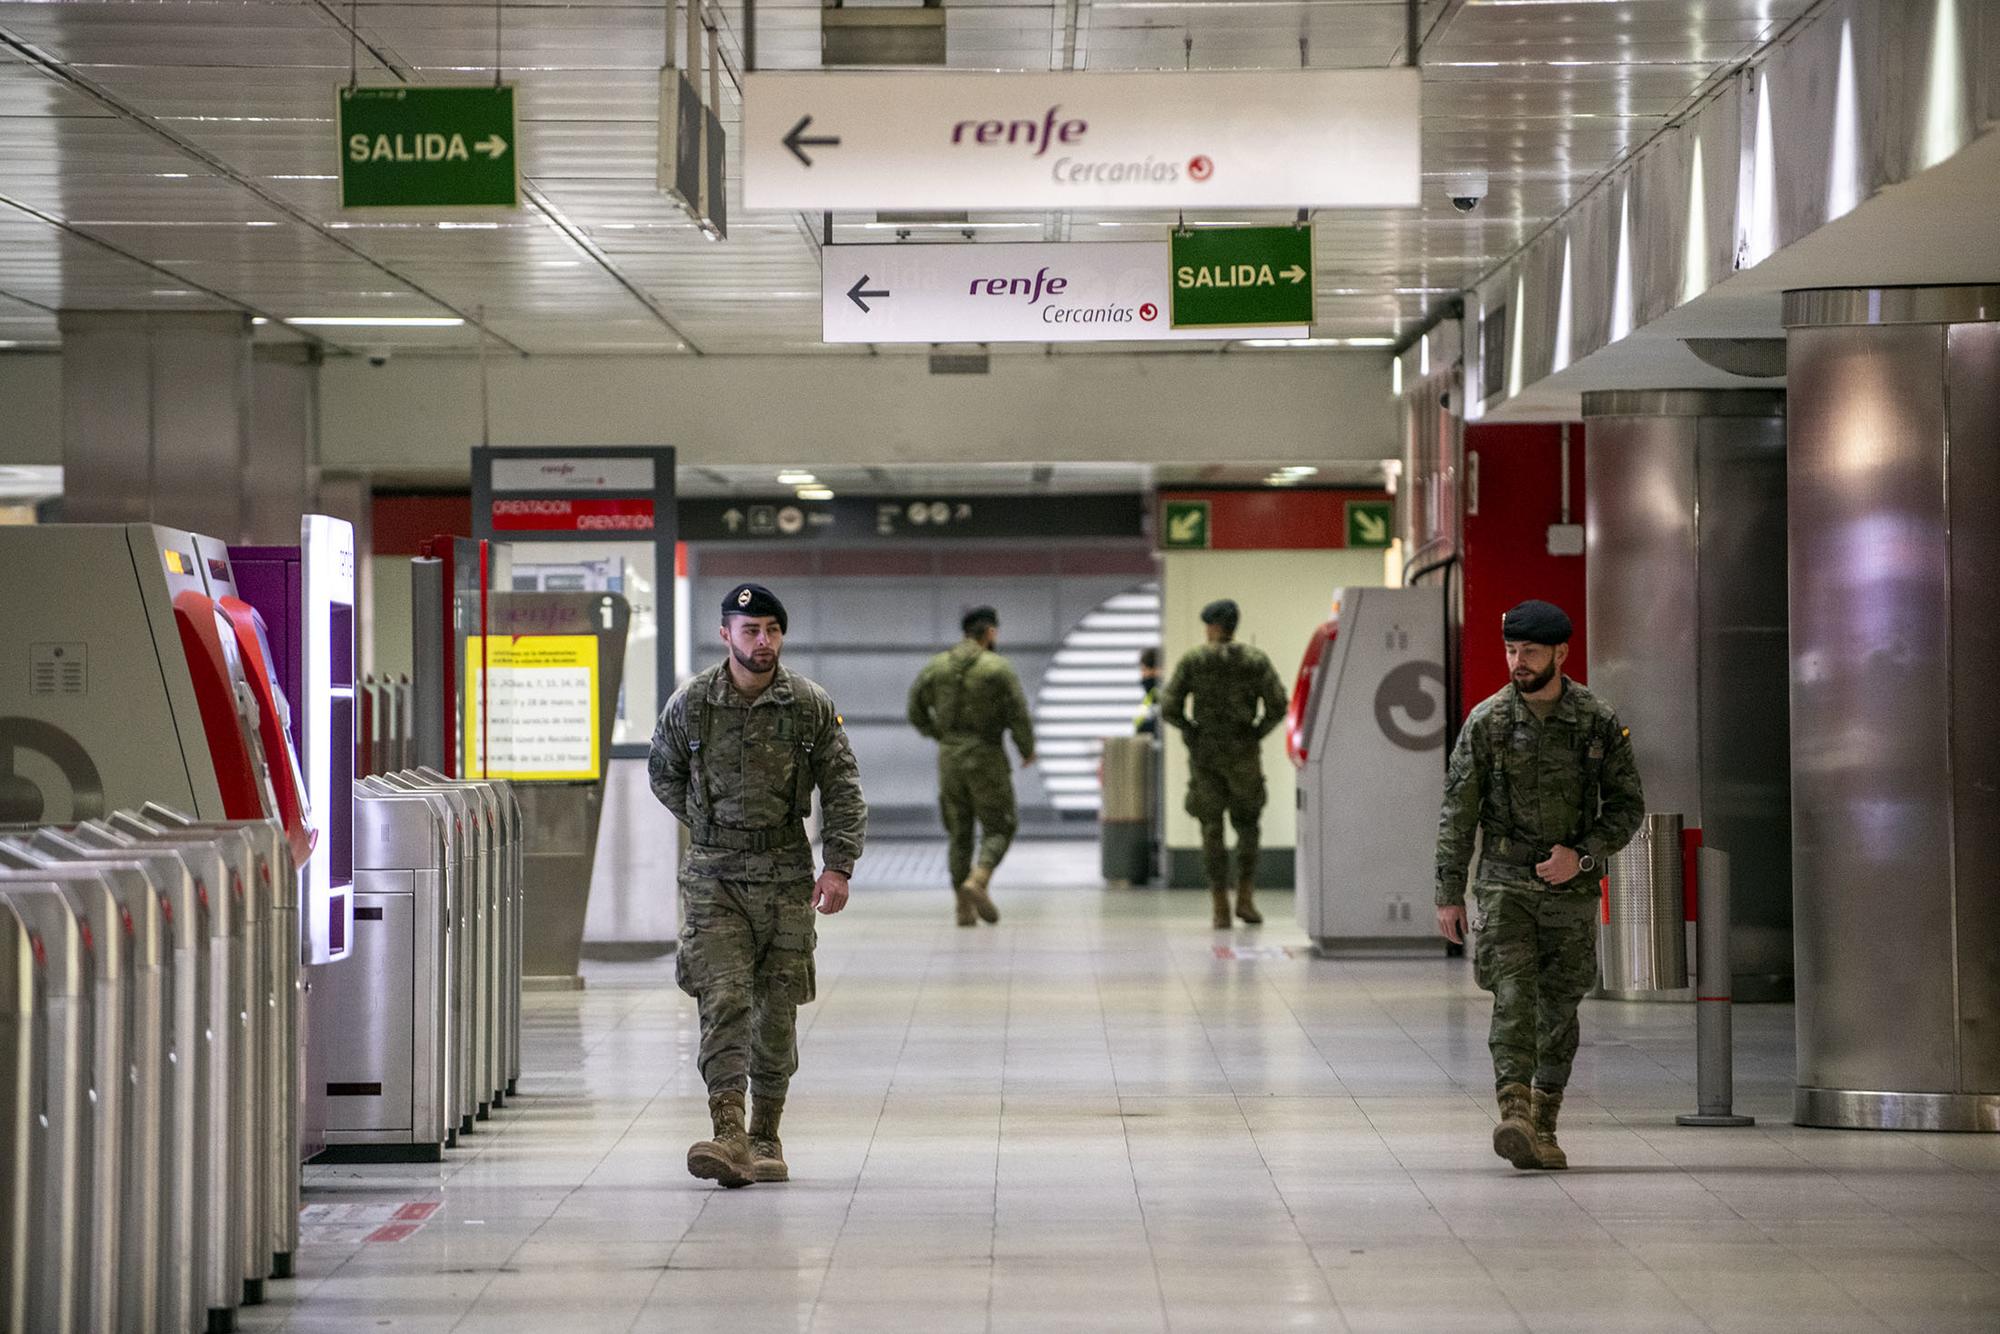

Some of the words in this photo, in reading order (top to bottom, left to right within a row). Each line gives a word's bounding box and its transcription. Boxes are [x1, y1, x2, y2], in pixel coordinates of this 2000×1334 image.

[951, 104, 1089, 156] renfe
[350, 134, 469, 161] SALIDA
[1053, 155, 1180, 183] Cercanías
[969, 267, 1068, 305] renfe
[1177, 264, 1275, 288] SALIDA
[1042, 303, 1134, 324] Cercanías
